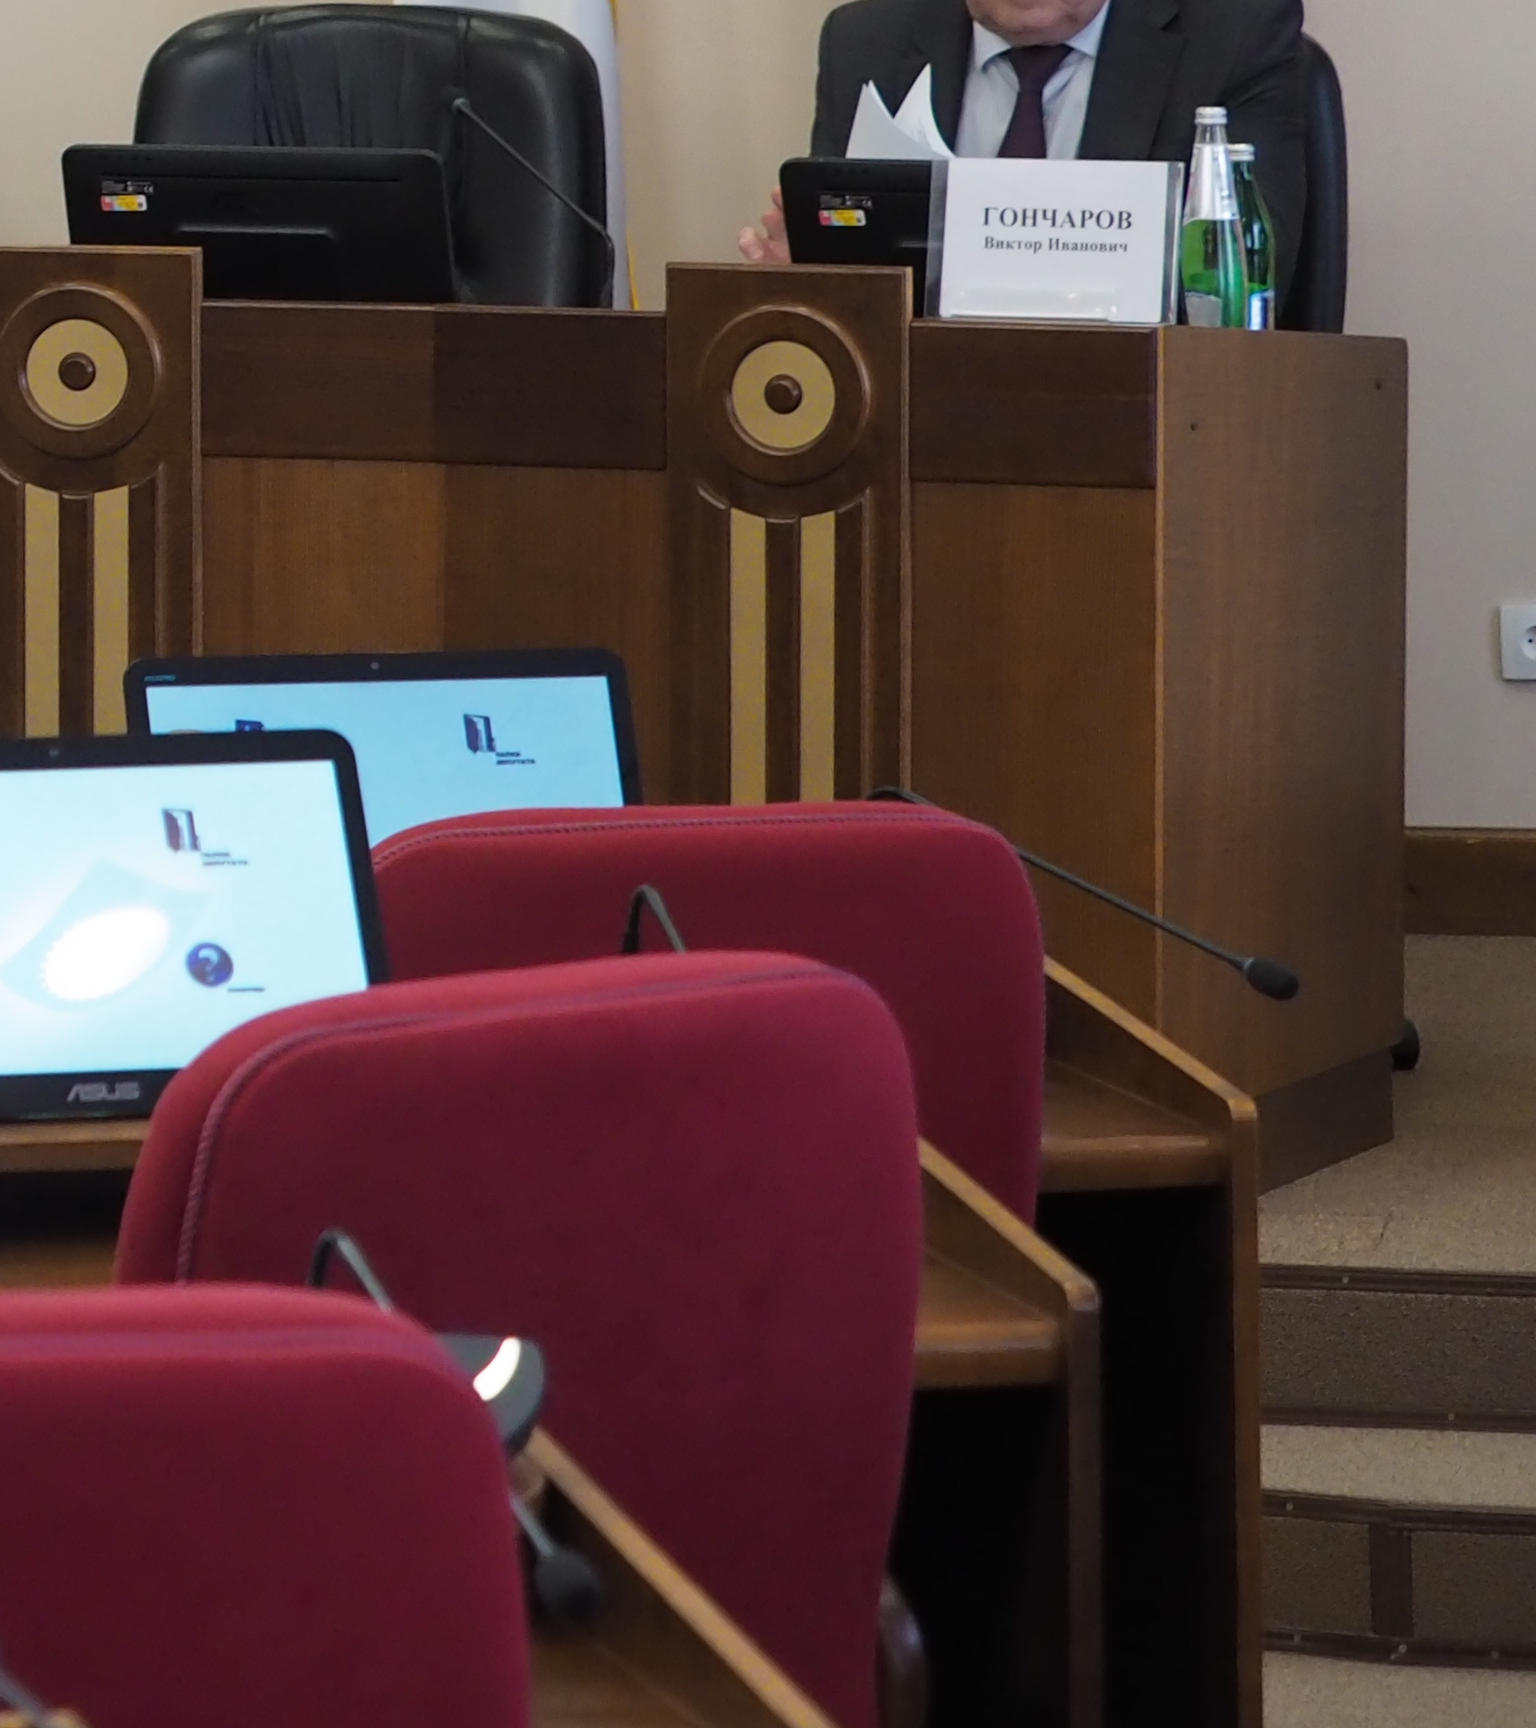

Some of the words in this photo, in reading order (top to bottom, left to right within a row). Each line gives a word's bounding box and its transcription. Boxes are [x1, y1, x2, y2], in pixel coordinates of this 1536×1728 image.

[982, 206, 1132, 230] ГОНЧАРОВ
[983, 235, 1042, 254] Виктор
[1048, 237, 1128, 252] Иванович
[65, 1081, 140, 1102] ASUS
